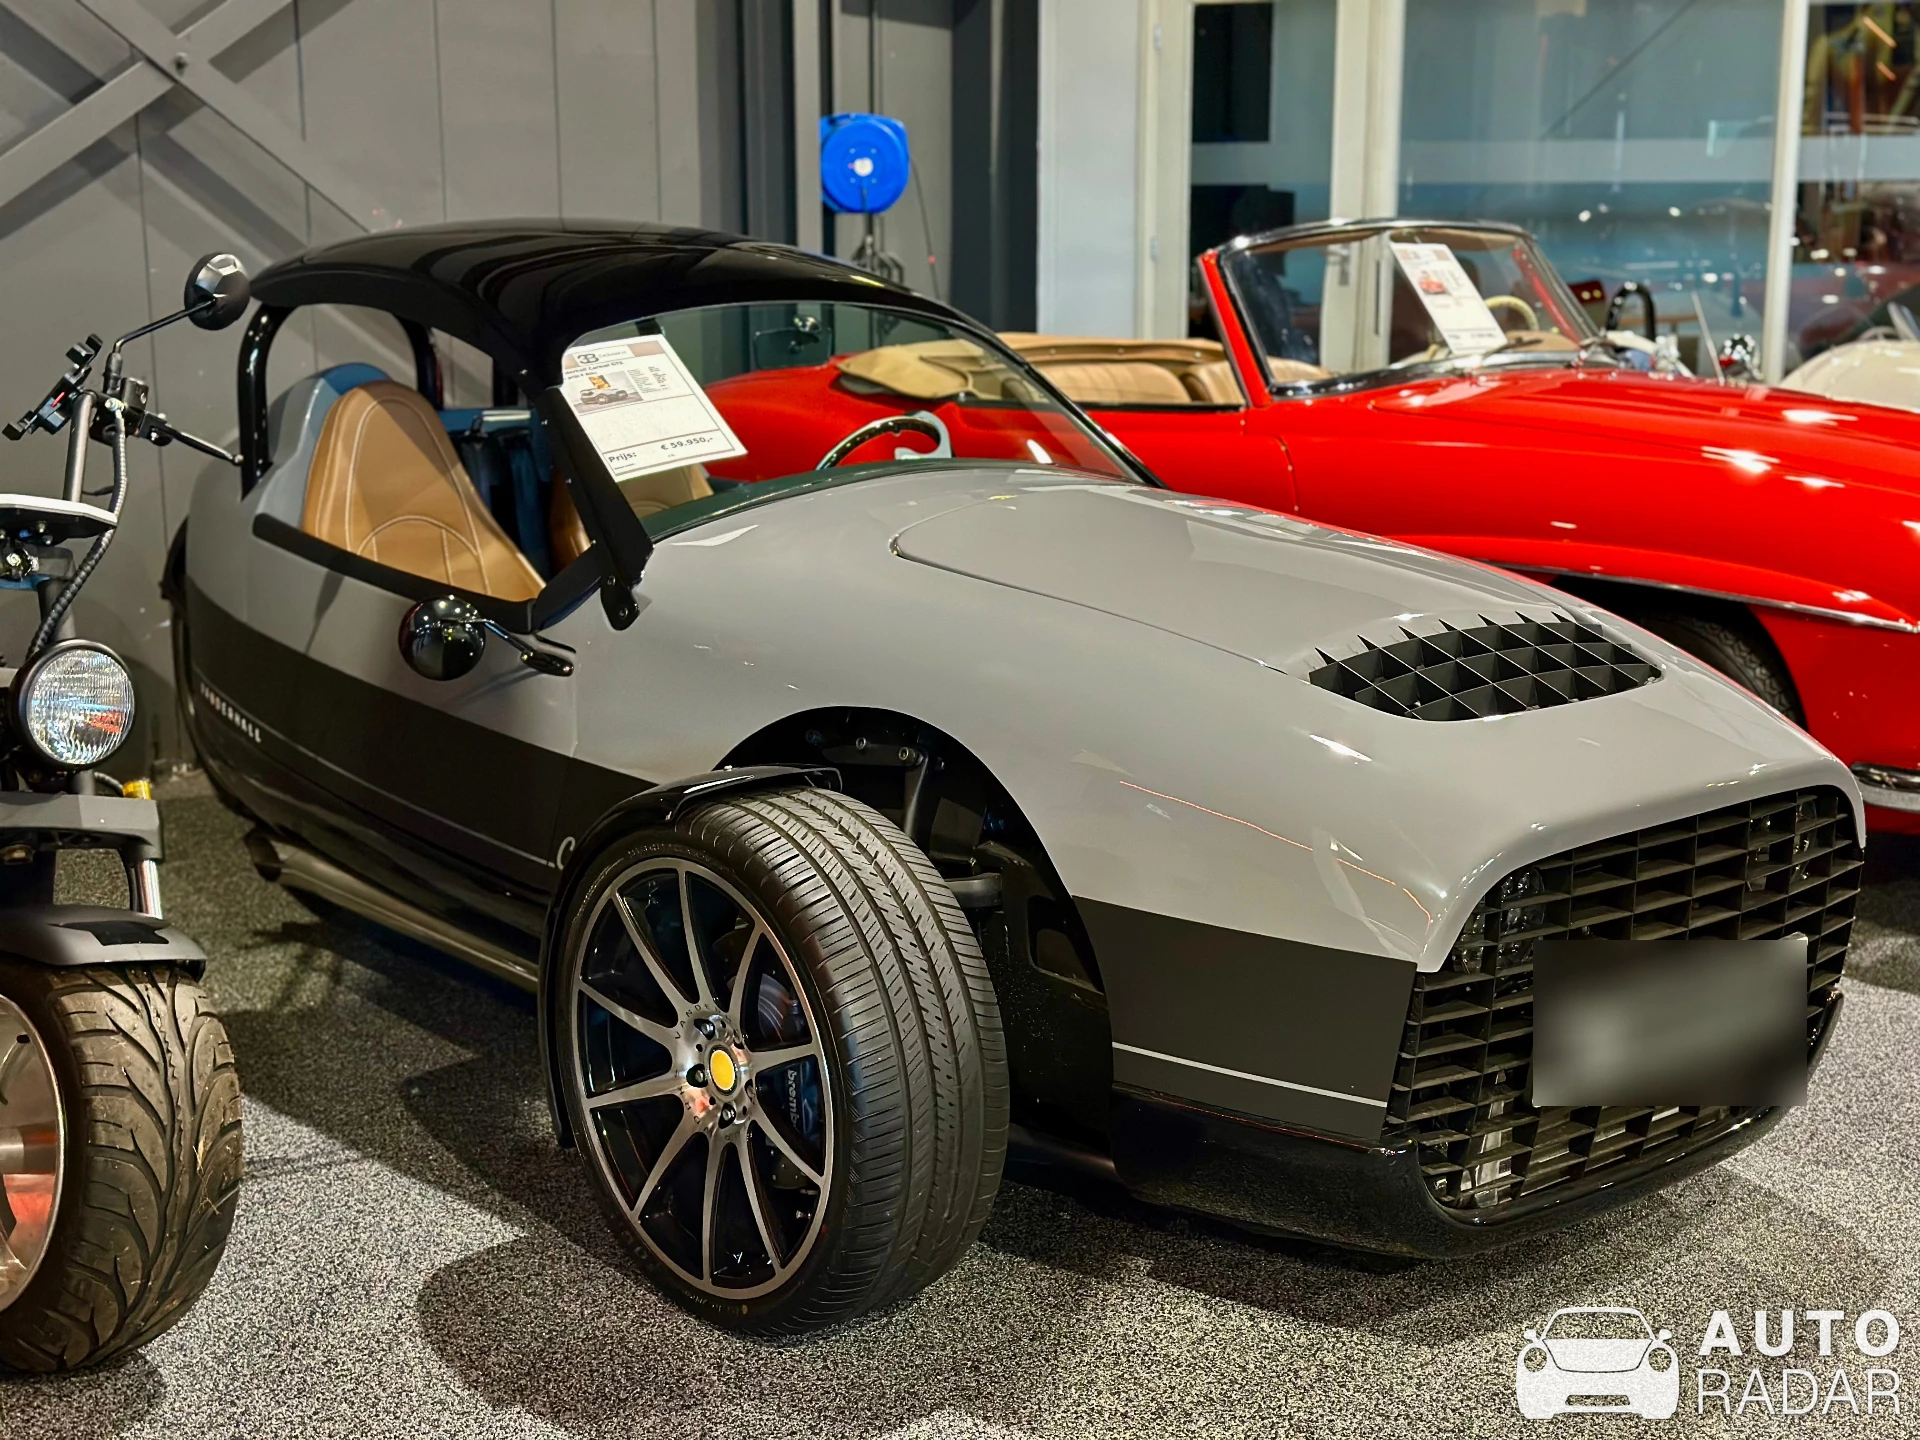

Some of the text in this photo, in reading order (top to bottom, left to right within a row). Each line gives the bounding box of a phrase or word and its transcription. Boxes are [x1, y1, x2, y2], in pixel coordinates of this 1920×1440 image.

[670, 436, 714, 450] 59.950,-
[608, 450, 637, 463] Prijs:
[556, 836, 576, 871] C
